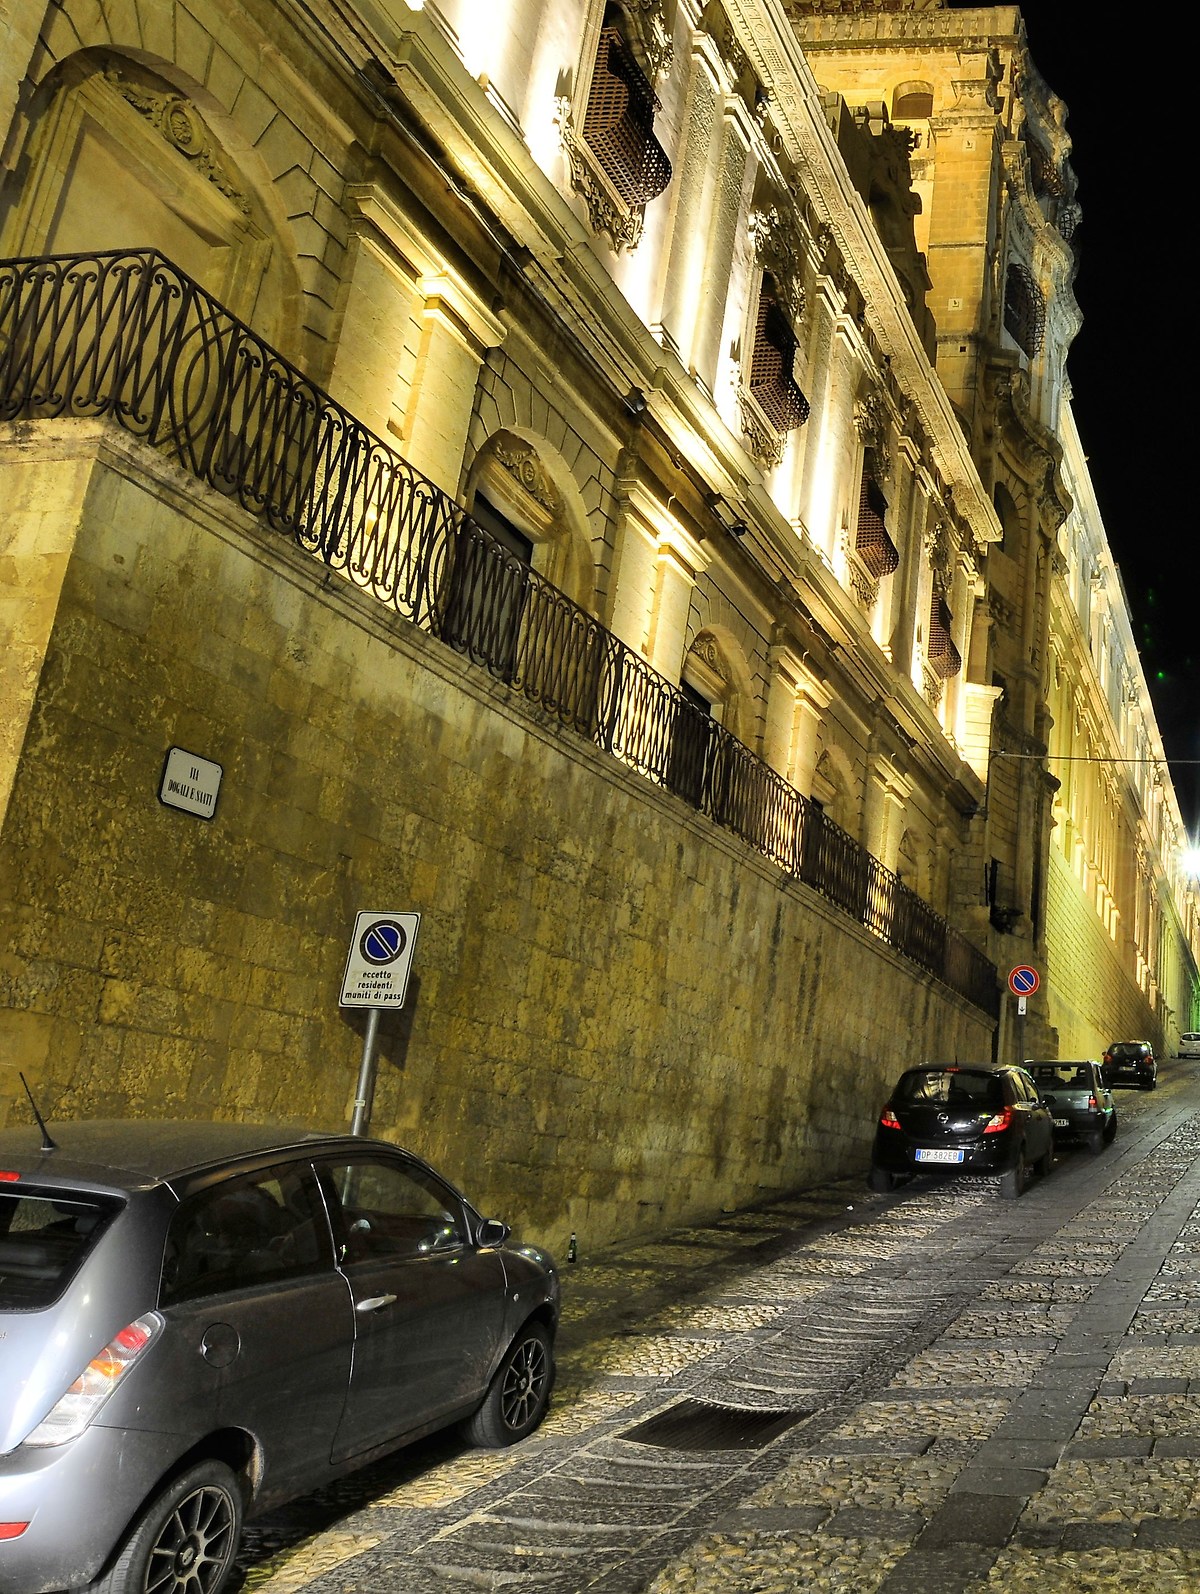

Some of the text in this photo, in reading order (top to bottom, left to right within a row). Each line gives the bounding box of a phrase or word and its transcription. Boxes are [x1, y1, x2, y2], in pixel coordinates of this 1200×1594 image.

[362, 970, 392, 979] eccetto
[357, 980, 393, 990] residenti
[344, 990, 401, 1002] muniti di pass
